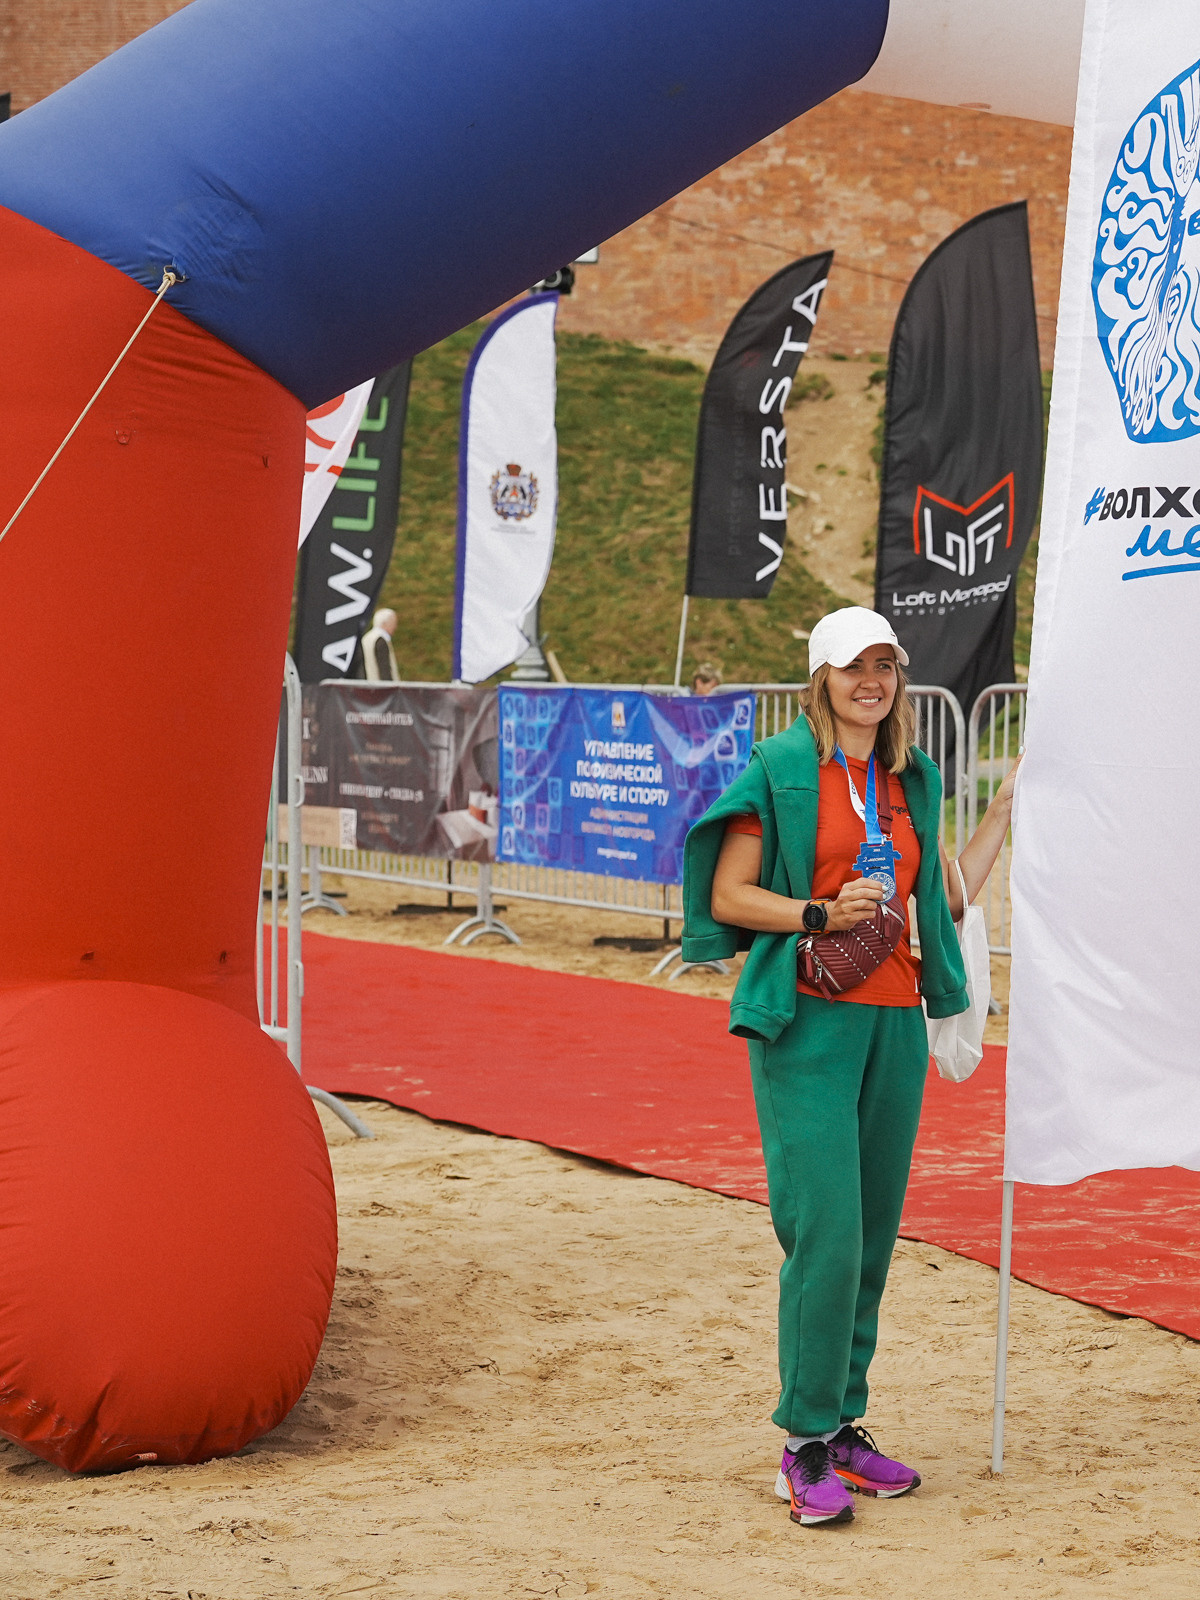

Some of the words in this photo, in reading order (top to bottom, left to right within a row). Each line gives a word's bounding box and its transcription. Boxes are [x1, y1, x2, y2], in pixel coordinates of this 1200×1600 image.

[756, 279, 828, 582] VERSTA
[893, 591, 936, 606] Loft
[584, 739, 655, 761] УПРАВЛЕНИЕ
[628, 786, 669, 807] СПОРТУ
